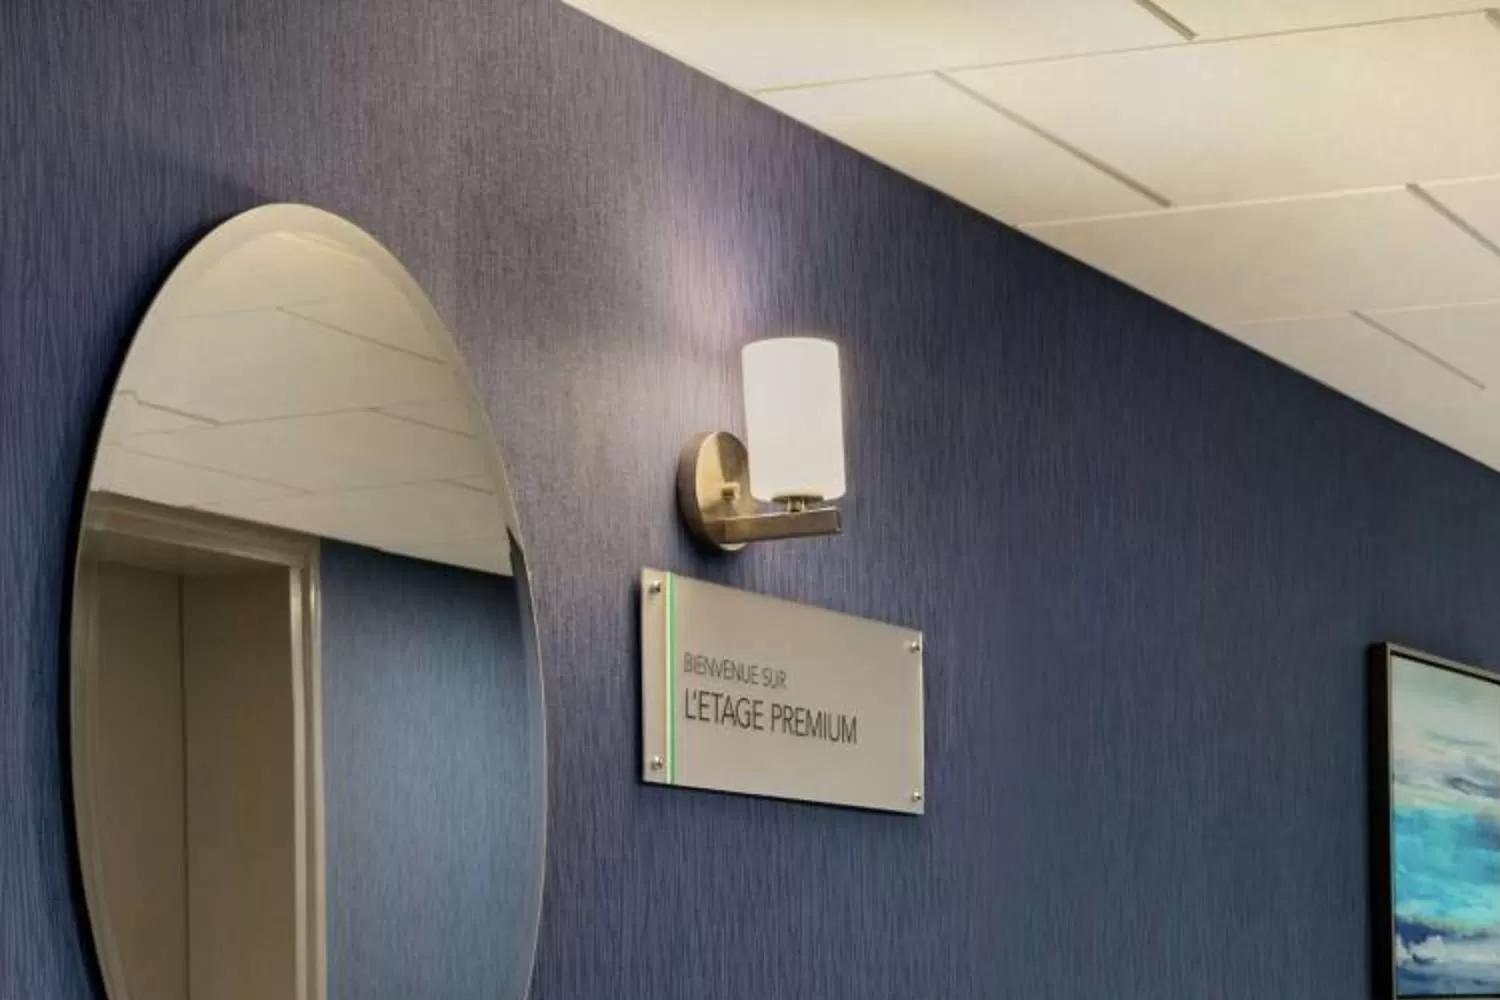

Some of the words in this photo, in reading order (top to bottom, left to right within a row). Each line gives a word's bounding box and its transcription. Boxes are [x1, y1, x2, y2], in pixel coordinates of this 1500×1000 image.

[683, 652, 758, 685] BIENVENUE
[761, 667, 787, 689] SUR
[684, 687, 764, 731] L'ETAGE
[770, 703, 858, 745] PREMIUM
